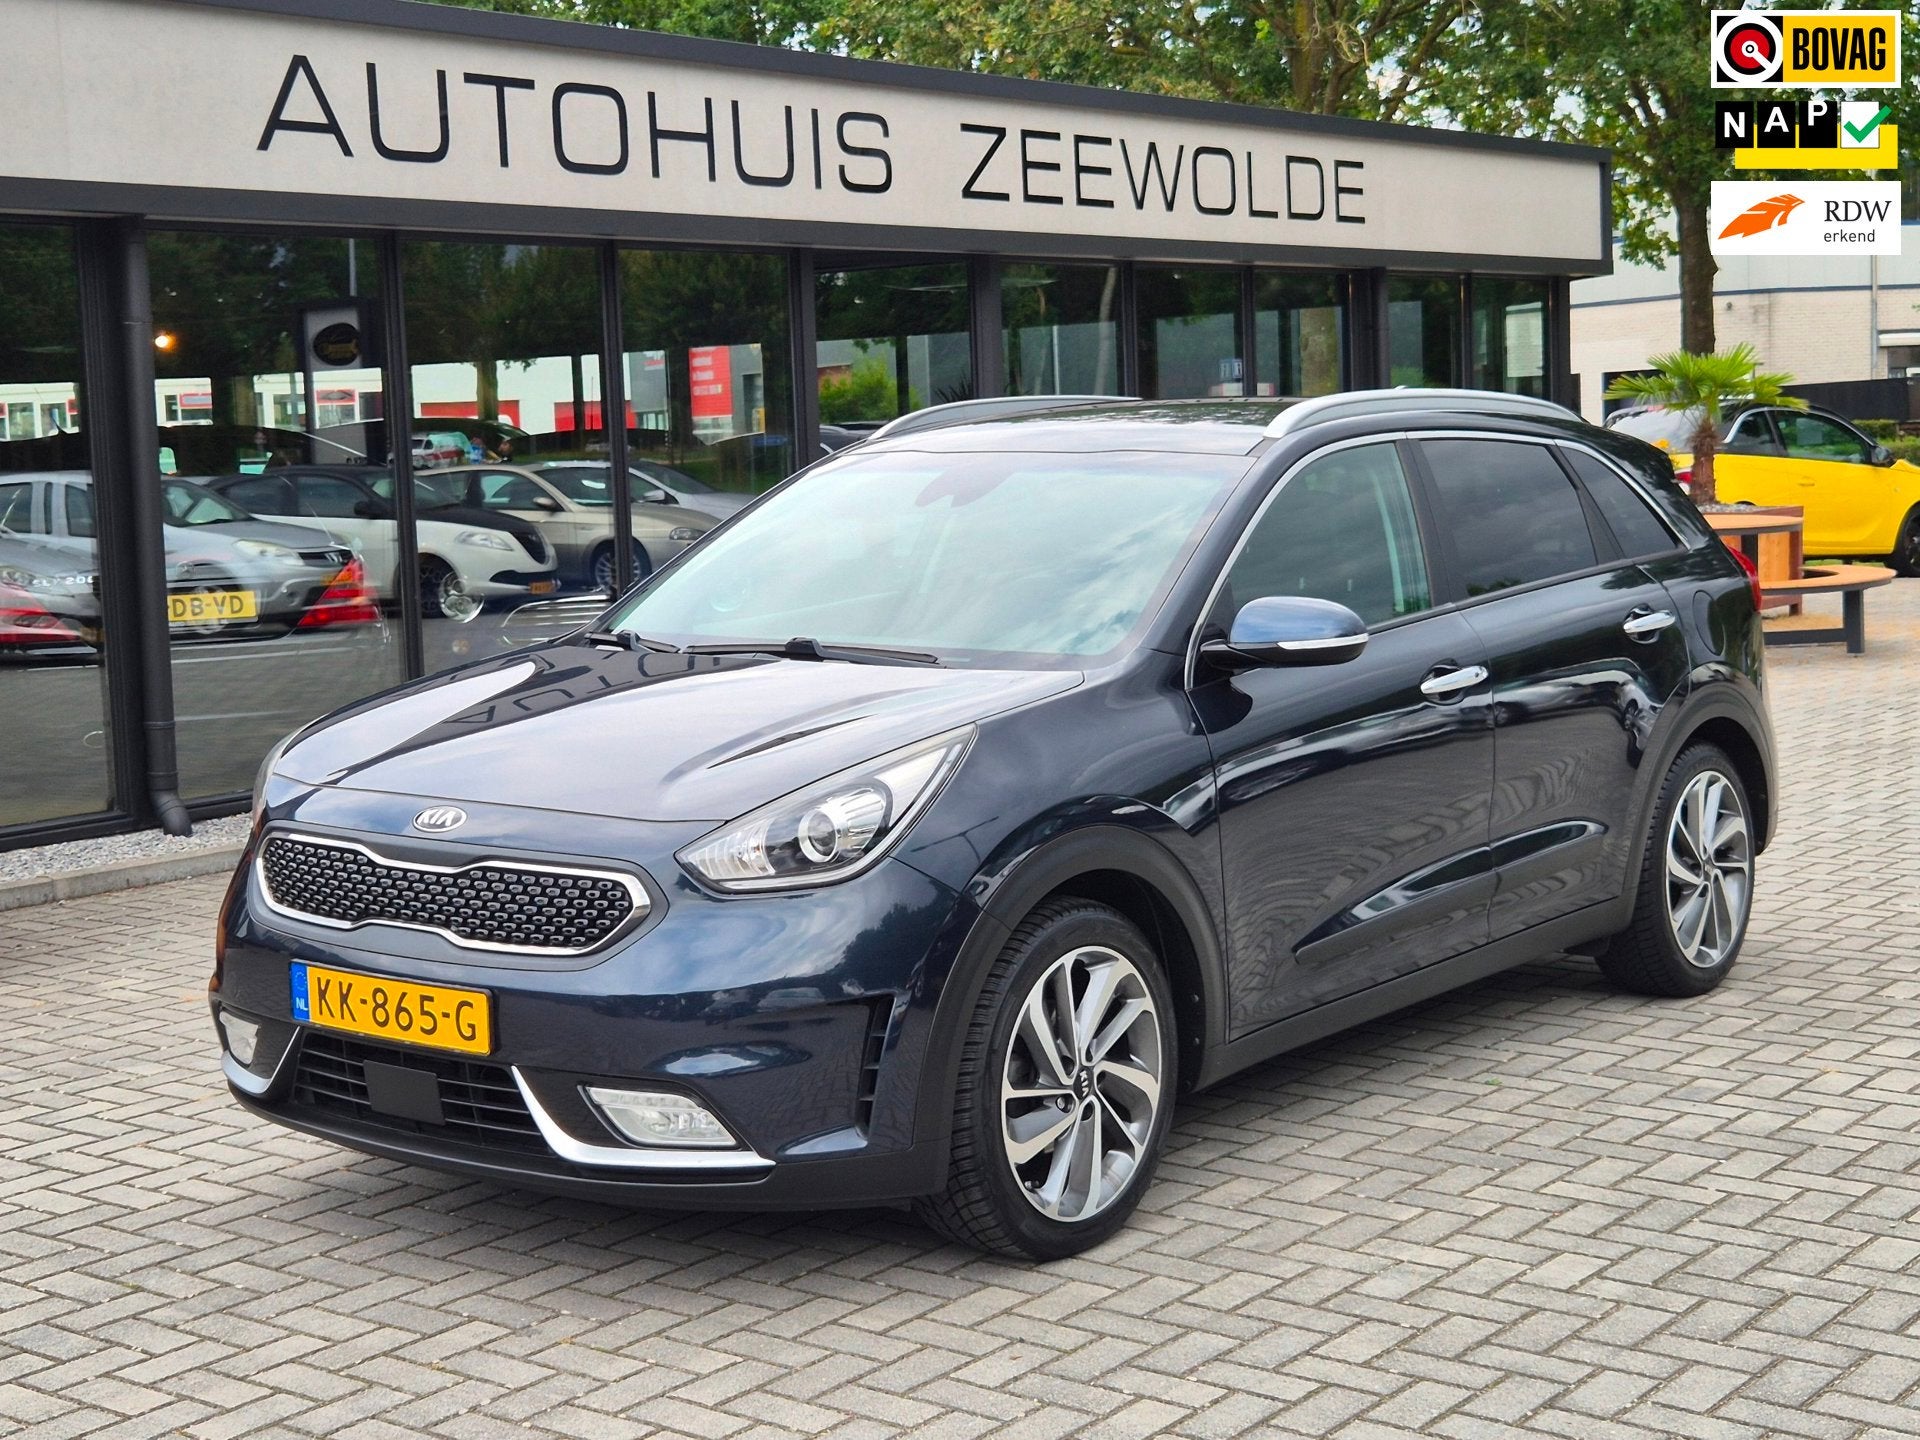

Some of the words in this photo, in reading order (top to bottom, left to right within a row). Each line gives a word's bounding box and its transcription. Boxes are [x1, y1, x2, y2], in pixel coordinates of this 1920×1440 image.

[256, 54, 892, 193] AUTOHUIS
[960, 123, 1366, 225] ZEEWOLDE
[416, 809, 456, 826] KIA
[295, 996, 309, 1011] NL
[316, 976, 477, 1041] KK-865-G
[1079, 1070, 1089, 1097] KIA
